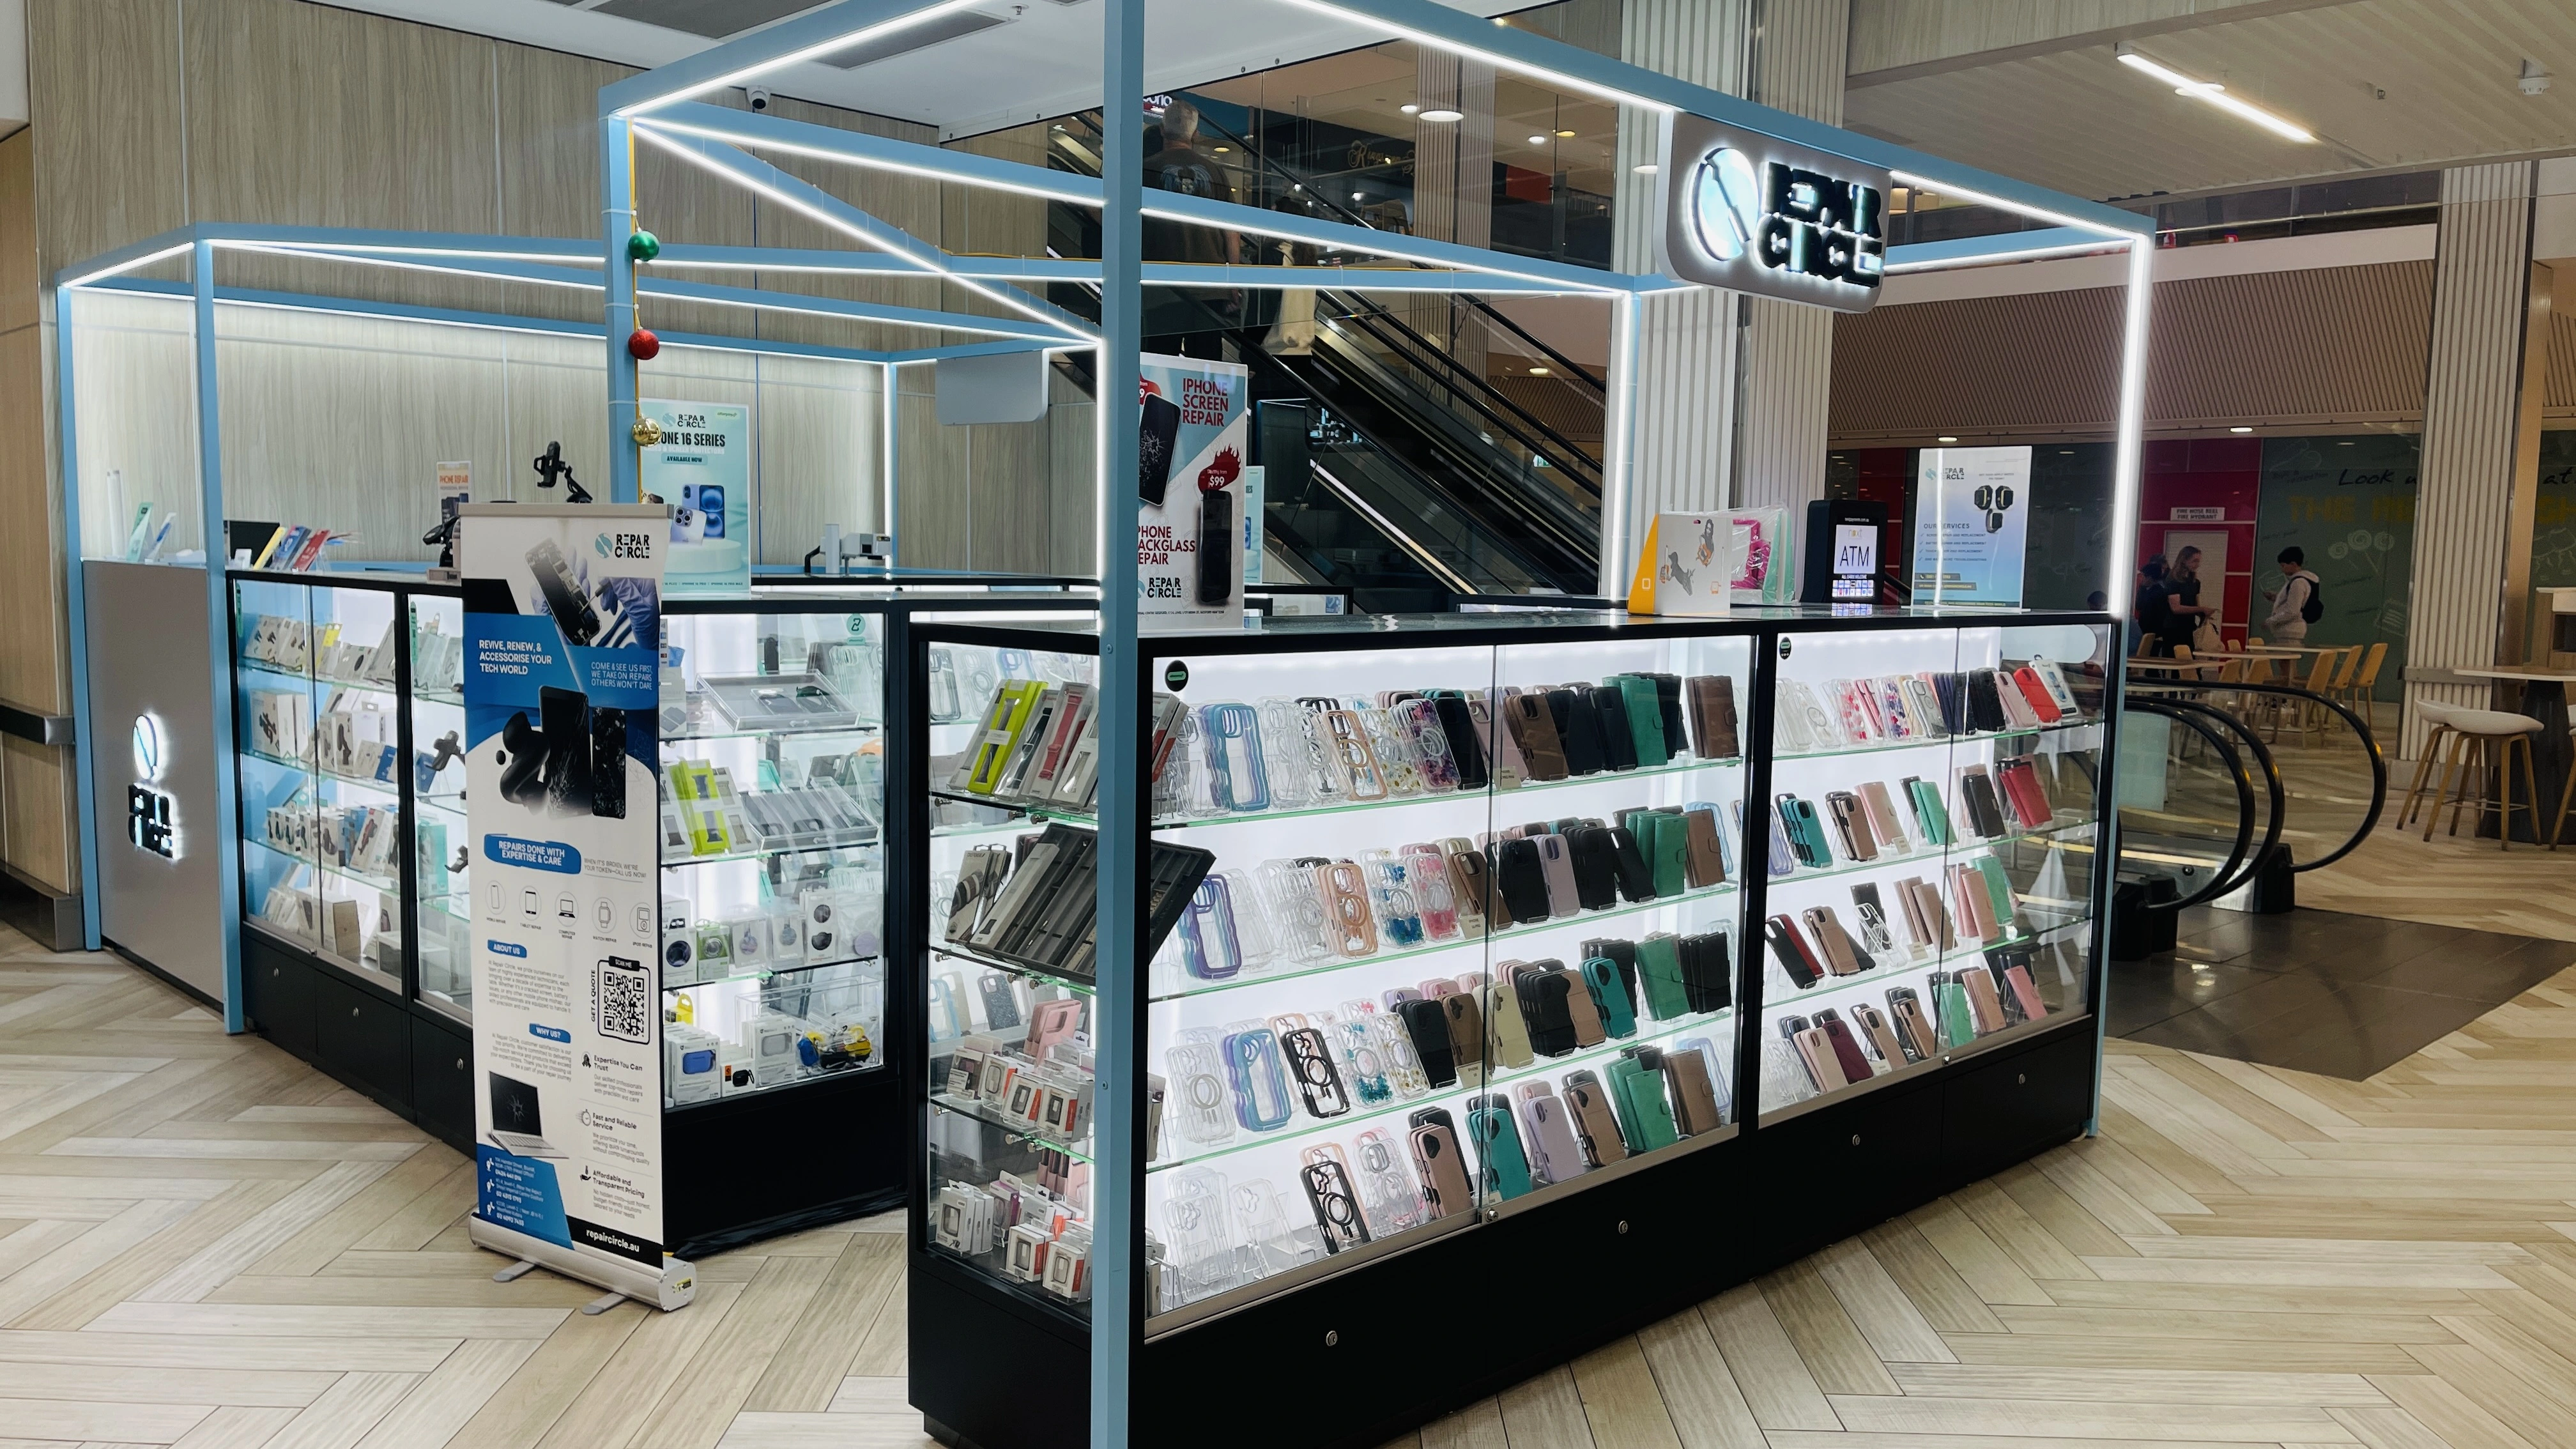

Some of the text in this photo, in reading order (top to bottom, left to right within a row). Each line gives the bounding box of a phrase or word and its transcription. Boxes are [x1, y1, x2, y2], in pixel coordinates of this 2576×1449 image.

[1183, 378, 1227, 396] IPHONE
[1183, 394, 1229, 411] SCREEN
[1183, 410, 1224, 427] REPAIR
[658, 431, 725, 447] ONE 16 SERIES
[1209, 475, 1225, 487] $99
[2338, 468, 2395, 486] Look
[1138, 526, 1171, 538] HONE
[617, 534, 649, 546] REPAR
[1138, 539, 1195, 552] ACKGLASS
[615, 546, 650, 558] CIRCLE
[1840, 546, 1869, 567] ATM
[1138, 553, 1169, 565] EPAIR
[1149, 578, 1181, 587] REPAIR
[1147, 588, 1181, 598] CIRCLE
[479, 640, 542, 653] REVIVE, RENEW, &
[479, 652, 552, 664] ACCESSORISE YOUR
[480, 663, 528, 675] TECH WORLD
[591, 662, 610, 670] COME
[602, 671, 617, 679] TAKE
[629, 673, 652, 681] REPAIRS
[592, 678, 616, 687] OTHERS
[639, 682, 652, 690] DARE
[498, 841, 565, 858] REPAIRS DONE WITH
[502, 849, 562, 866] EXPERTISE & CARE
[493, 943, 520, 955] ABOUT US
[536, 1027, 561, 1039] WHY US?
[594, 1055, 619, 1066] Expertise
[594, 1063, 608, 1071] Trust
[593, 1112, 603, 1121] Fast
[617, 1118, 636, 1130] Reliable
[593, 1120, 613, 1131] Service
[593, 1170, 620, 1182] Affordable
[593, 1177, 645, 1199] Transparent Pricing
[586, 1229, 640, 1252] repaircircle.au
